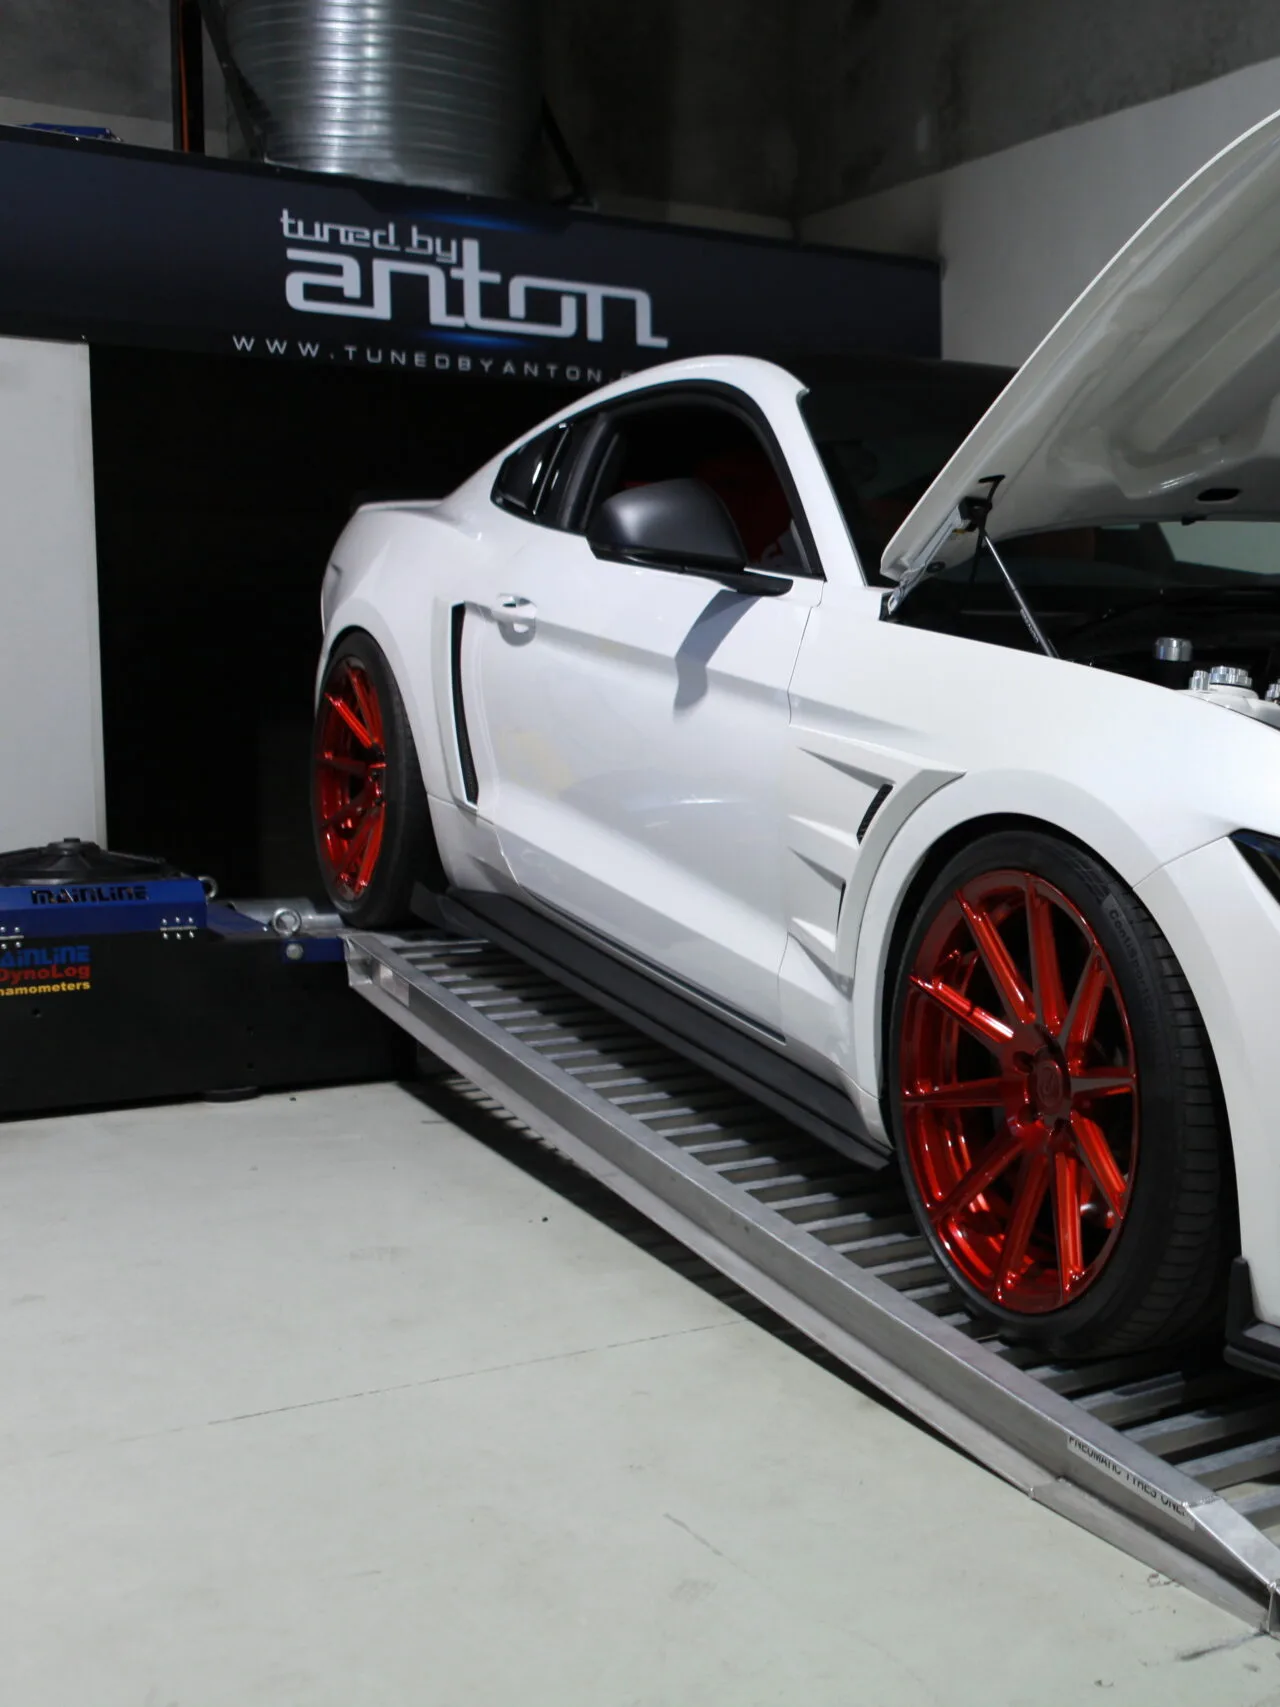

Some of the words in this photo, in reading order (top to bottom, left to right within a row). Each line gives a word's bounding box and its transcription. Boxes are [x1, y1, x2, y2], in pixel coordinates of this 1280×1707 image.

[280, 208, 401, 252] tuned
[405, 225, 458, 264] by
[285, 238, 669, 349] anton
[232, 335, 633, 384] WWW.TUNEDBYANTON.
